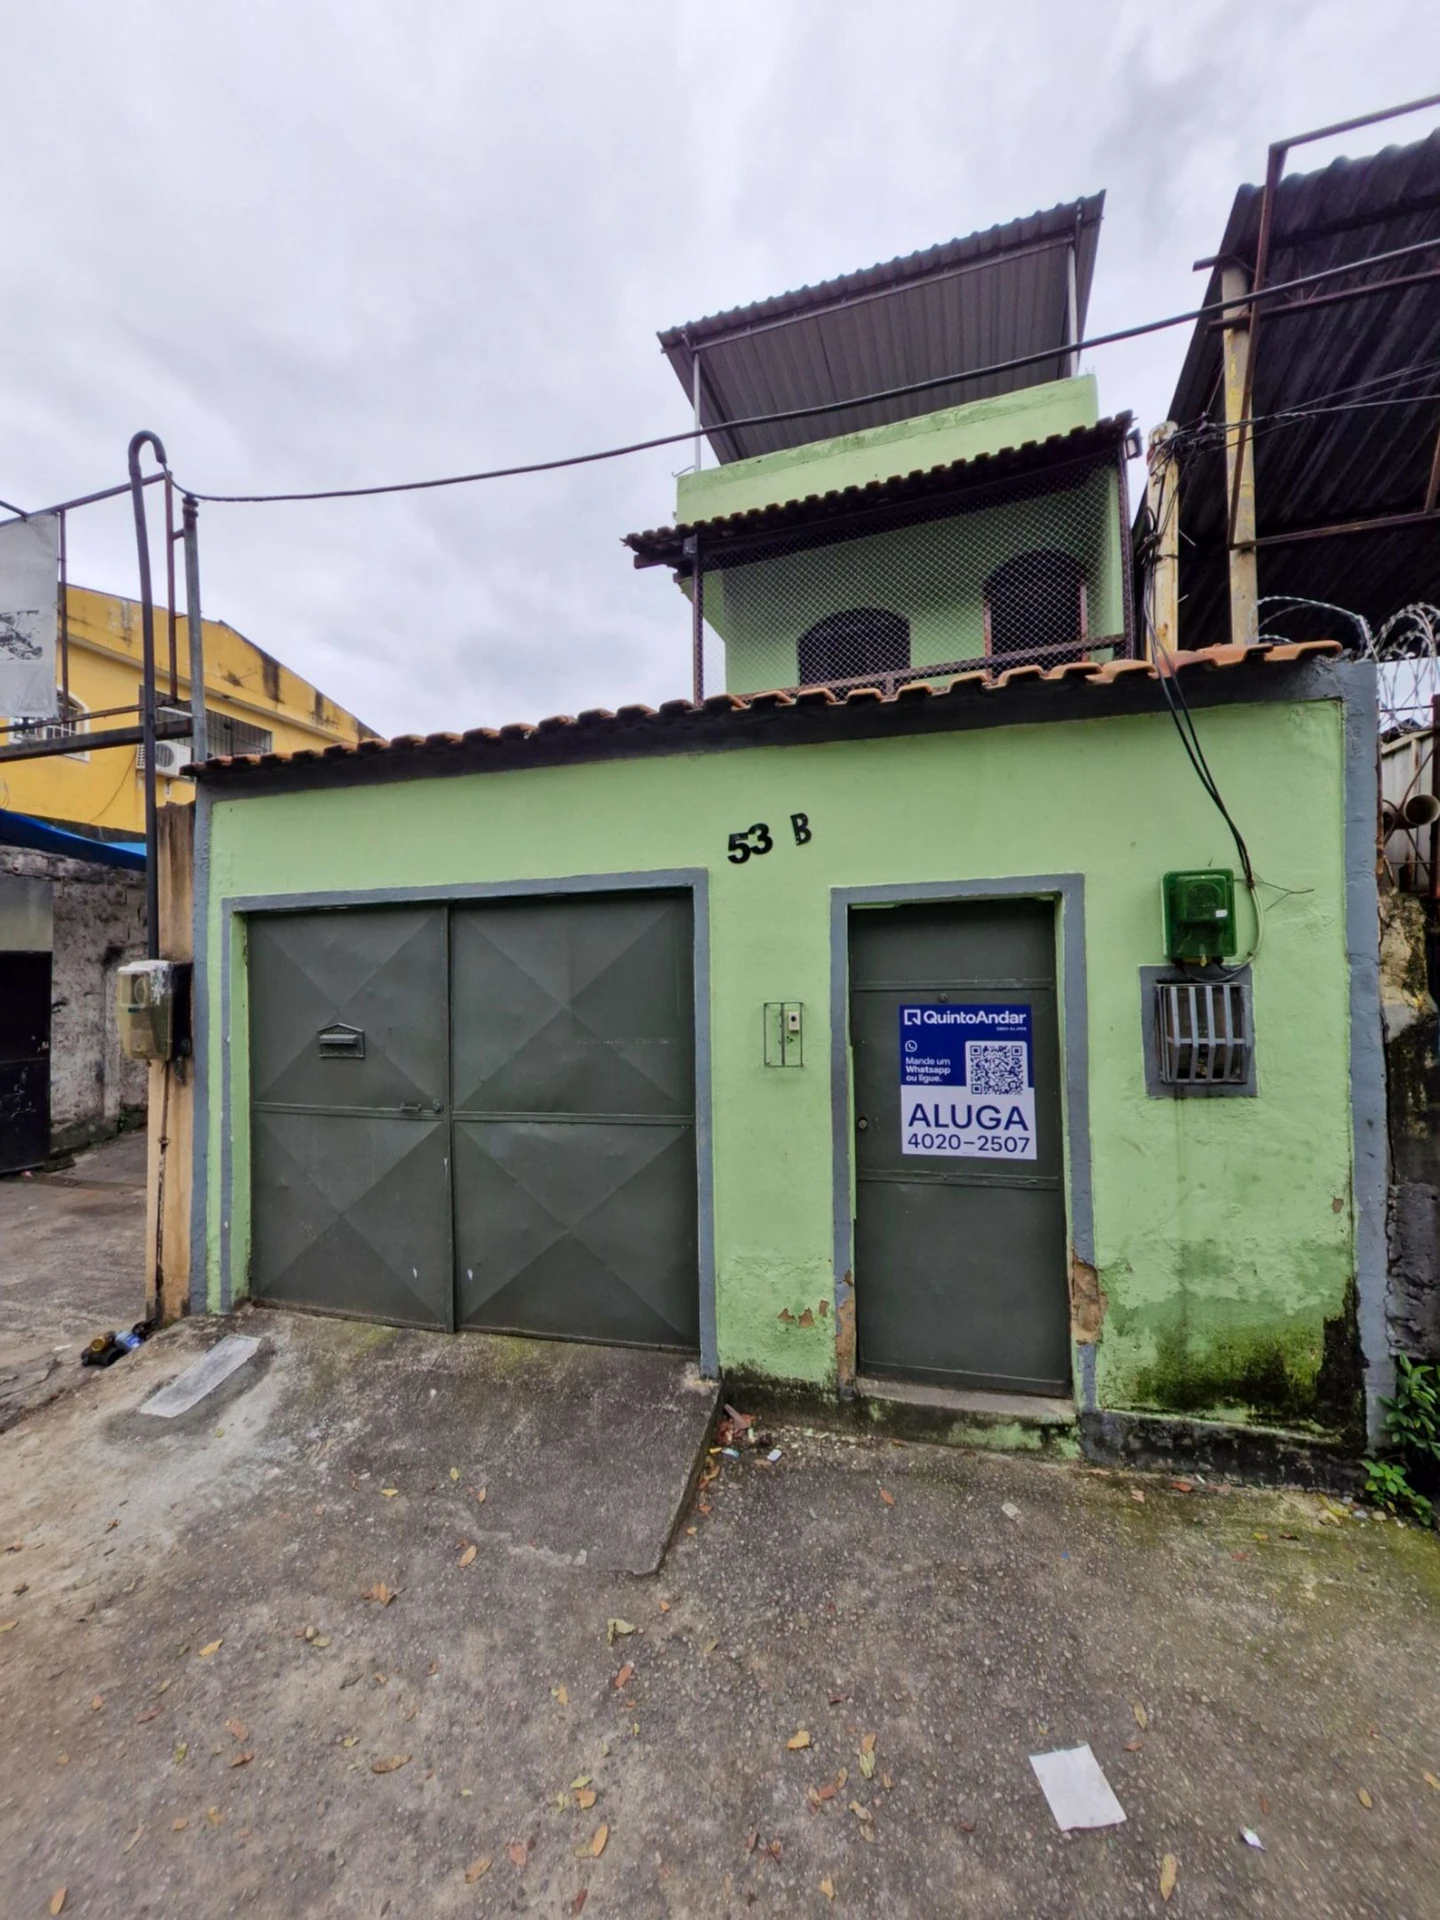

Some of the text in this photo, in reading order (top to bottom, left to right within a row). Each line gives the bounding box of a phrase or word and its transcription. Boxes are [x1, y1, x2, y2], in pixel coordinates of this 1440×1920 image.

[727, 812, 812, 865] 53 B
[923, 1010, 1027, 1025] QuintoAndar
[905, 1057, 951, 1066] Mande um
[905, 1065, 951, 1075] Whatsapp
[906, 1074, 942, 1084] ou ligue.
[908, 1103, 1030, 1132] ALUGA
[907, 1132, 1031, 1154] 4020-2507
